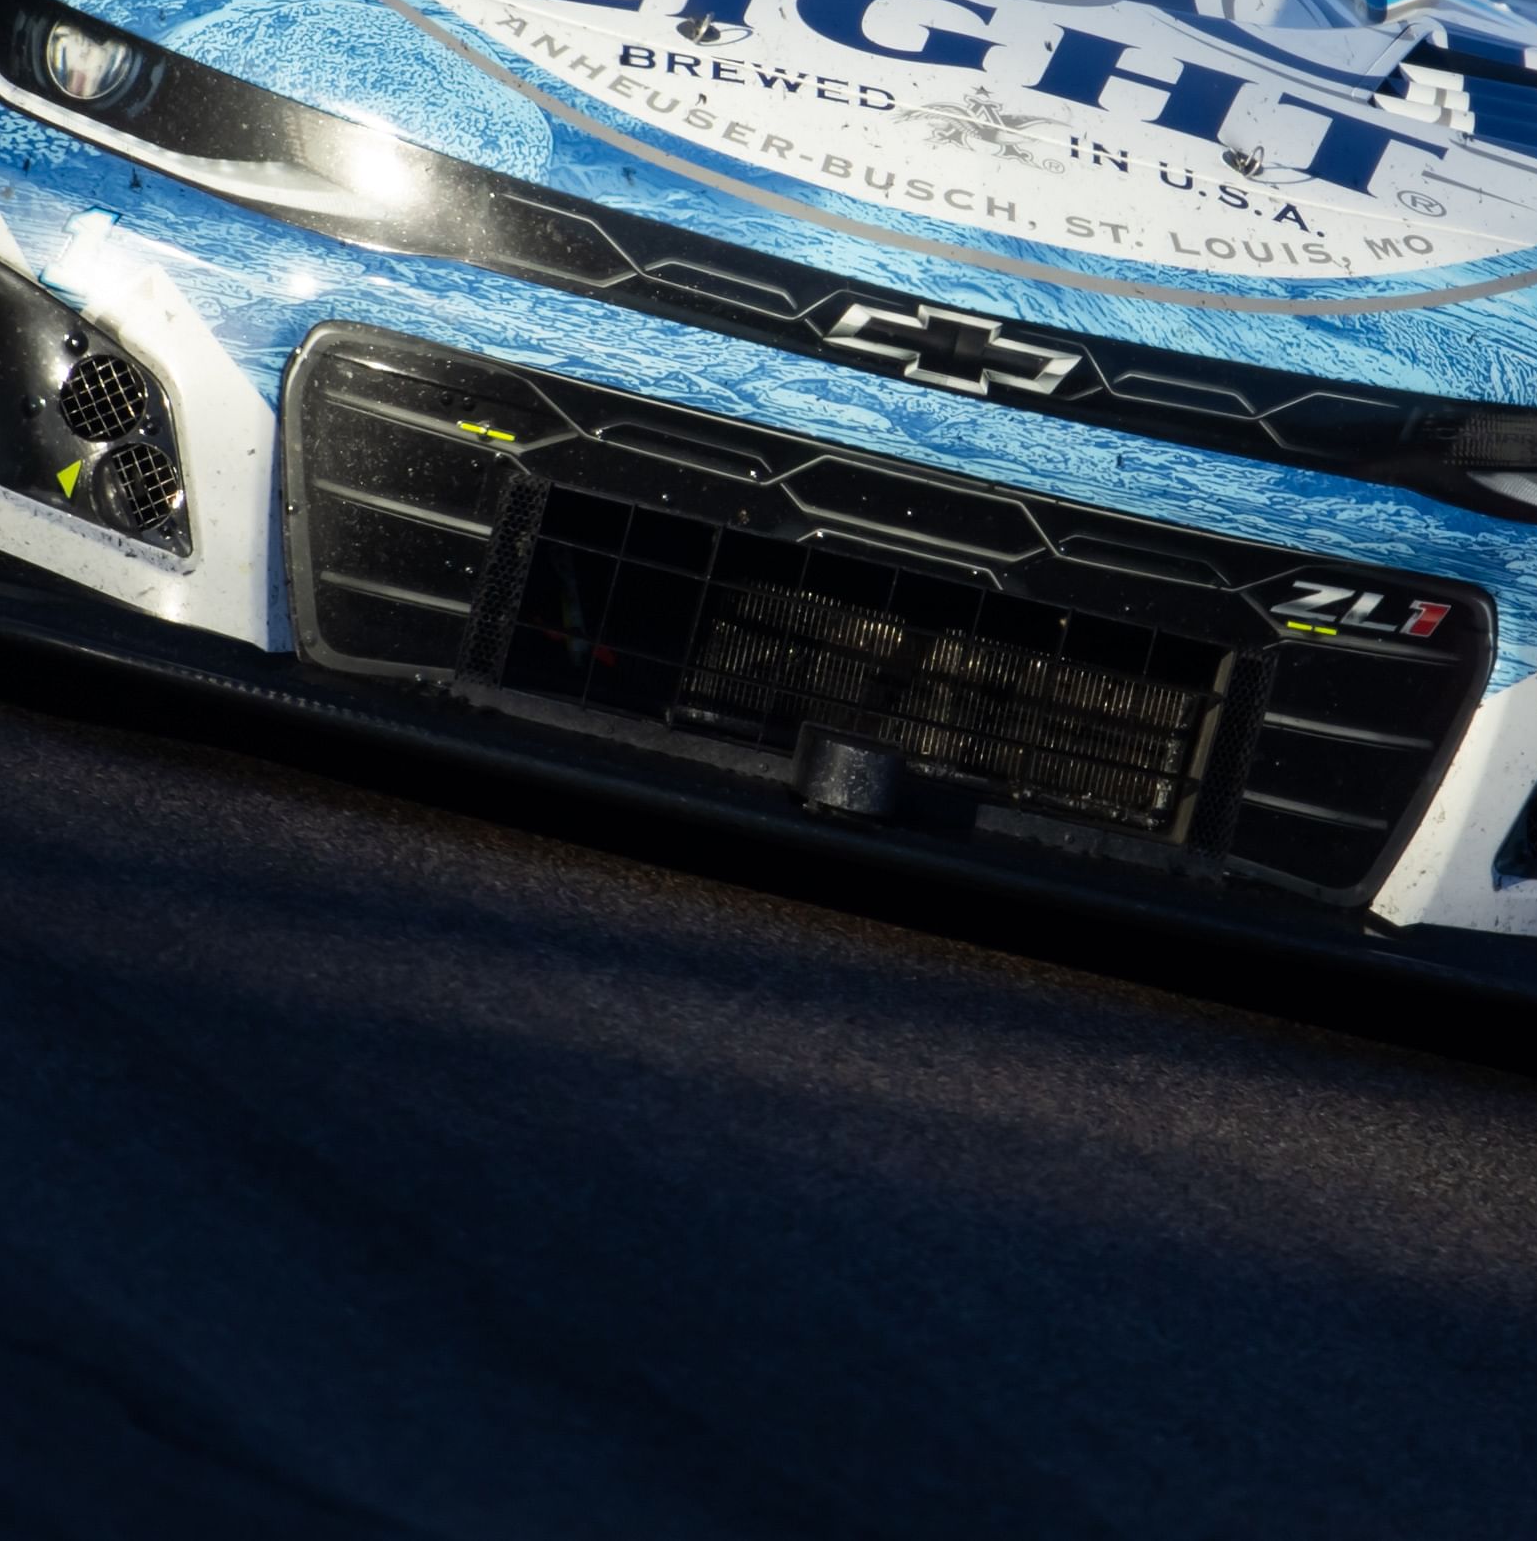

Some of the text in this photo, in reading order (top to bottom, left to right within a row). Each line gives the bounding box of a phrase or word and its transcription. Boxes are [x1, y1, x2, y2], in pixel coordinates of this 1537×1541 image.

[619, 44, 1326, 238] BREWED IN U.S.A.
[1065, 215, 1145, 248] ST.
[1365, 233, 1435, 261] MO
[1269, 580, 1453, 638] ZL1
